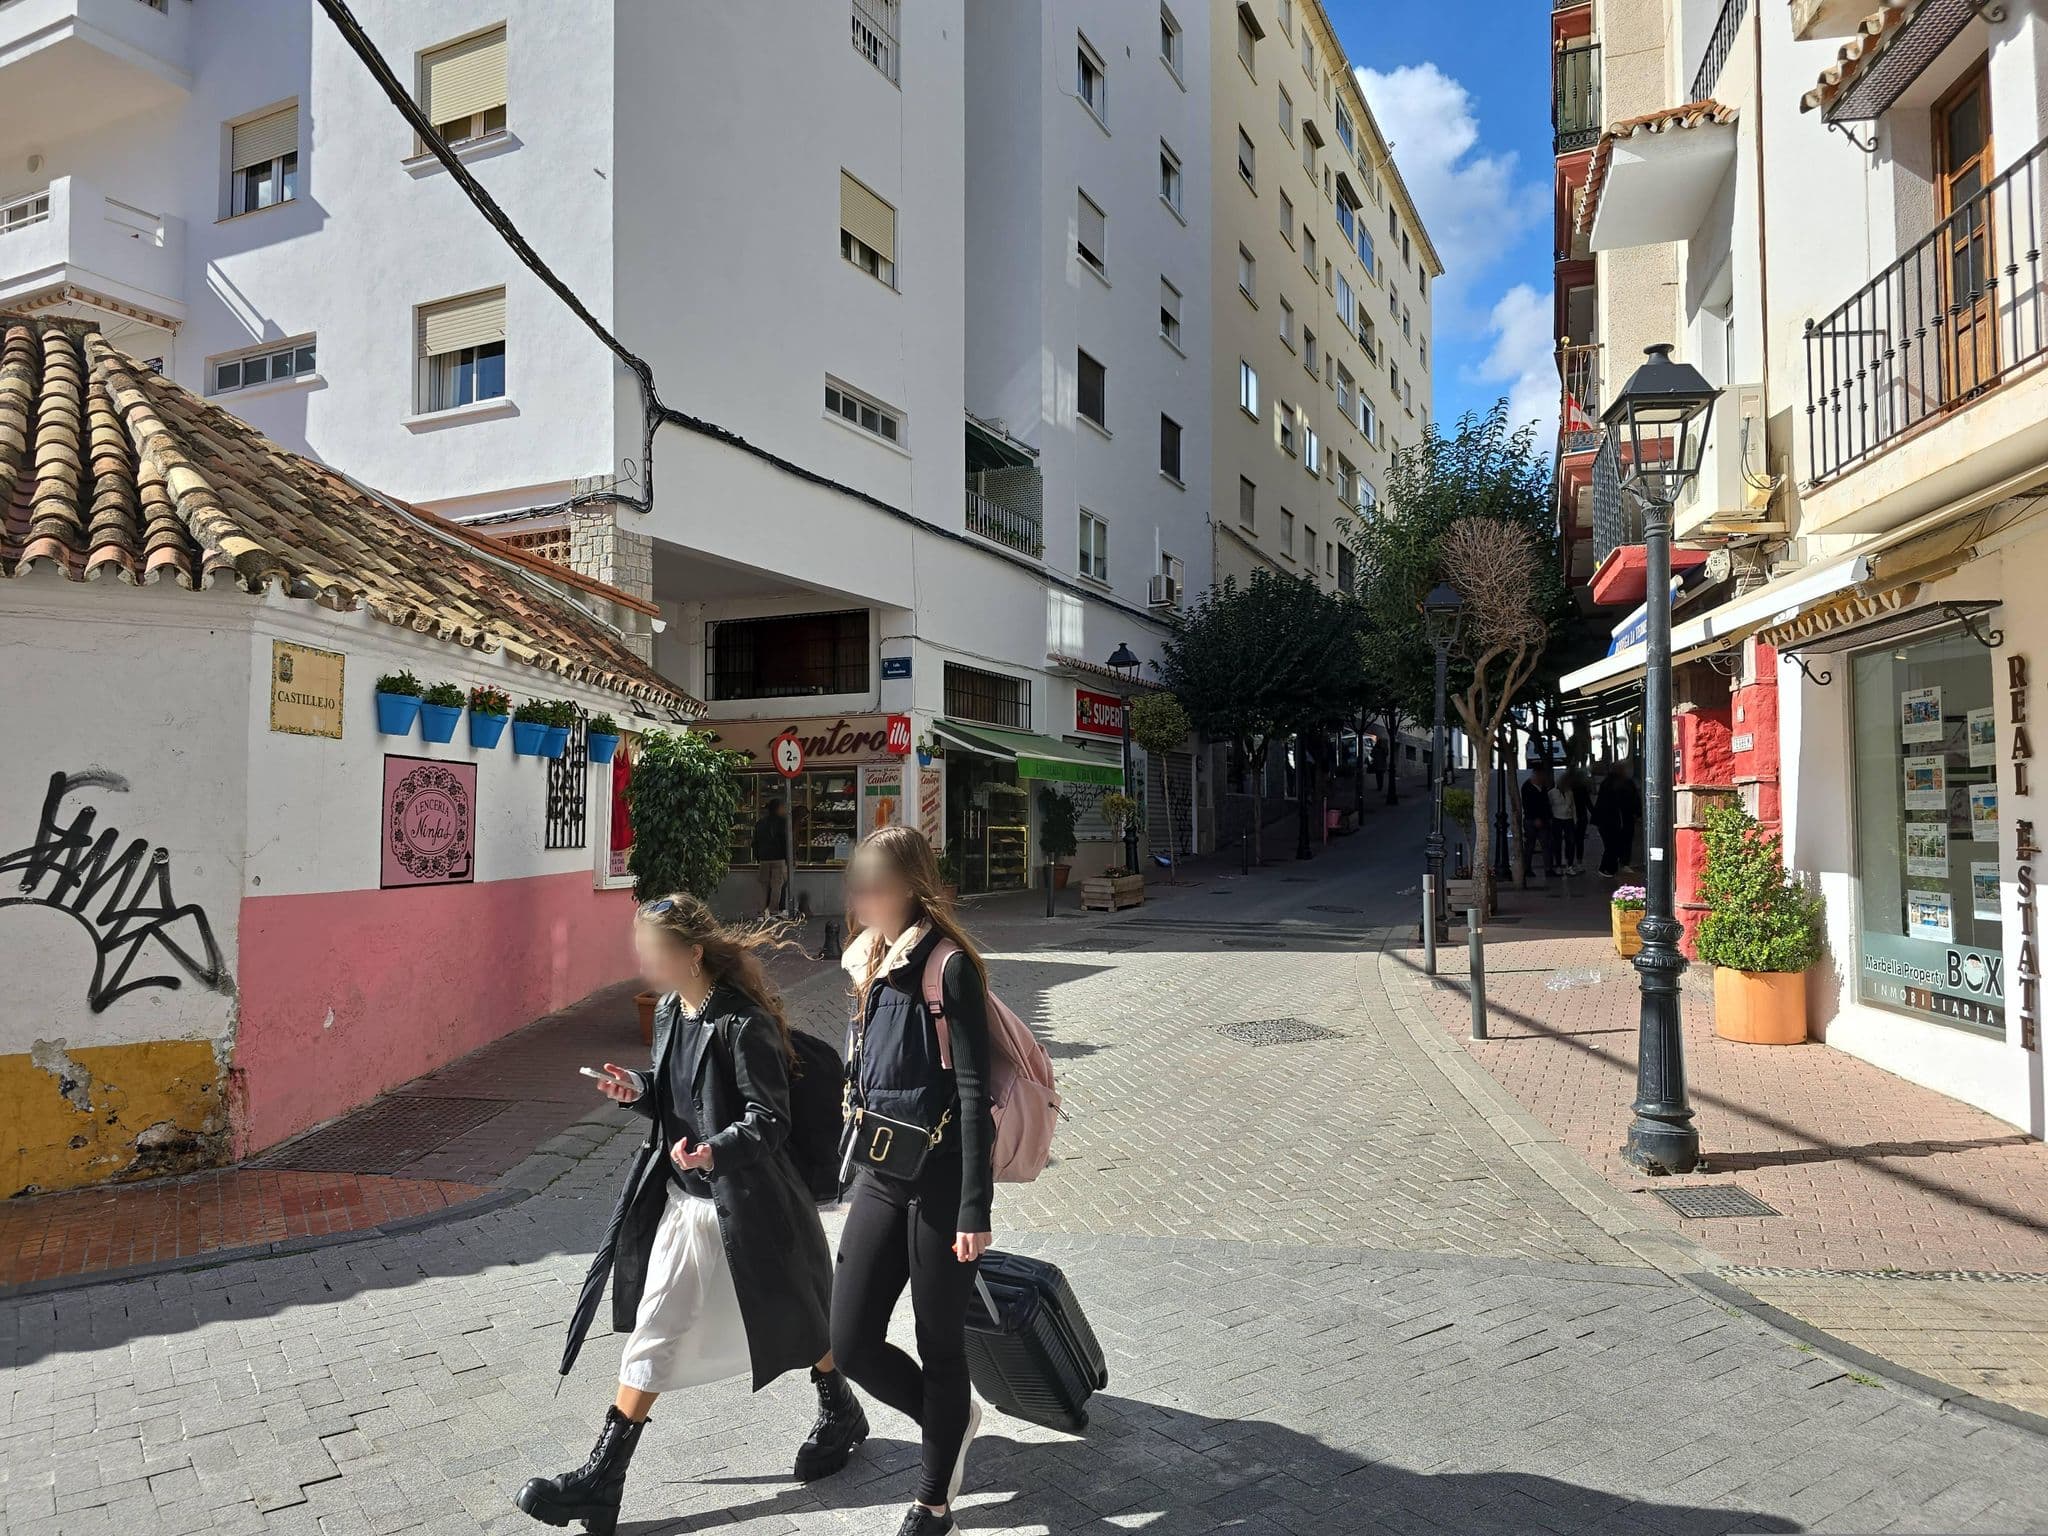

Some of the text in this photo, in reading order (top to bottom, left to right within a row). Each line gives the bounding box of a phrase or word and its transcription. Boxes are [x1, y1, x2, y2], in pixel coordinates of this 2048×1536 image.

[277, 690, 335, 710] CASTILLEJO
[1093, 703, 1122, 728] SUPER
[2007, 655, 2032, 797] REAL
[890, 722, 910, 750] illy
[786, 750, 792, 761] 2
[415, 800, 449, 817] LENCERIA
[2016, 819, 2035, 1052] ESTATE
[1865, 954, 1902, 977] Marbella
[1904, 962, 1945, 990] Property
[1873, 981, 1995, 1024] INMOBILIARIA
